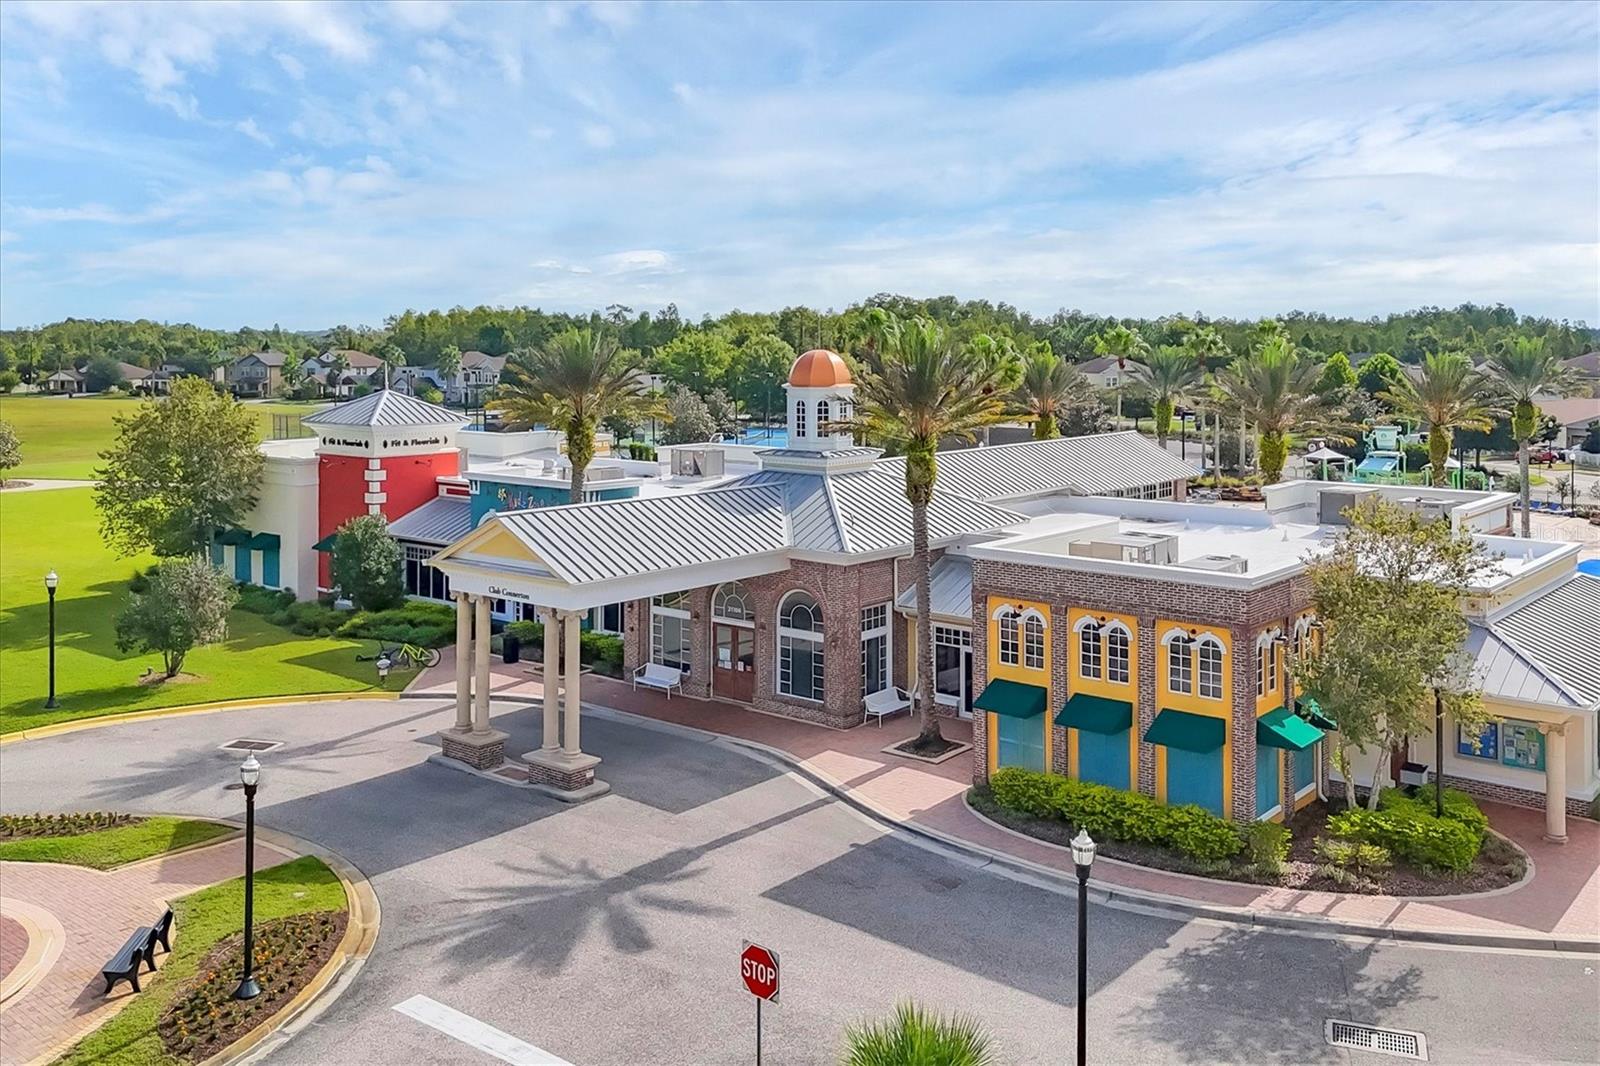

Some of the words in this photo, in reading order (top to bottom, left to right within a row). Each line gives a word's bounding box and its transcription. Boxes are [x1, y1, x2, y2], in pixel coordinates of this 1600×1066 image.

[342, 439, 363, 447] Flourish
[391, 439, 401, 447] Fit
[411, 437, 440, 446] Flourish
[488, 585, 501, 594] Club
[743, 958, 776, 986] STOP
